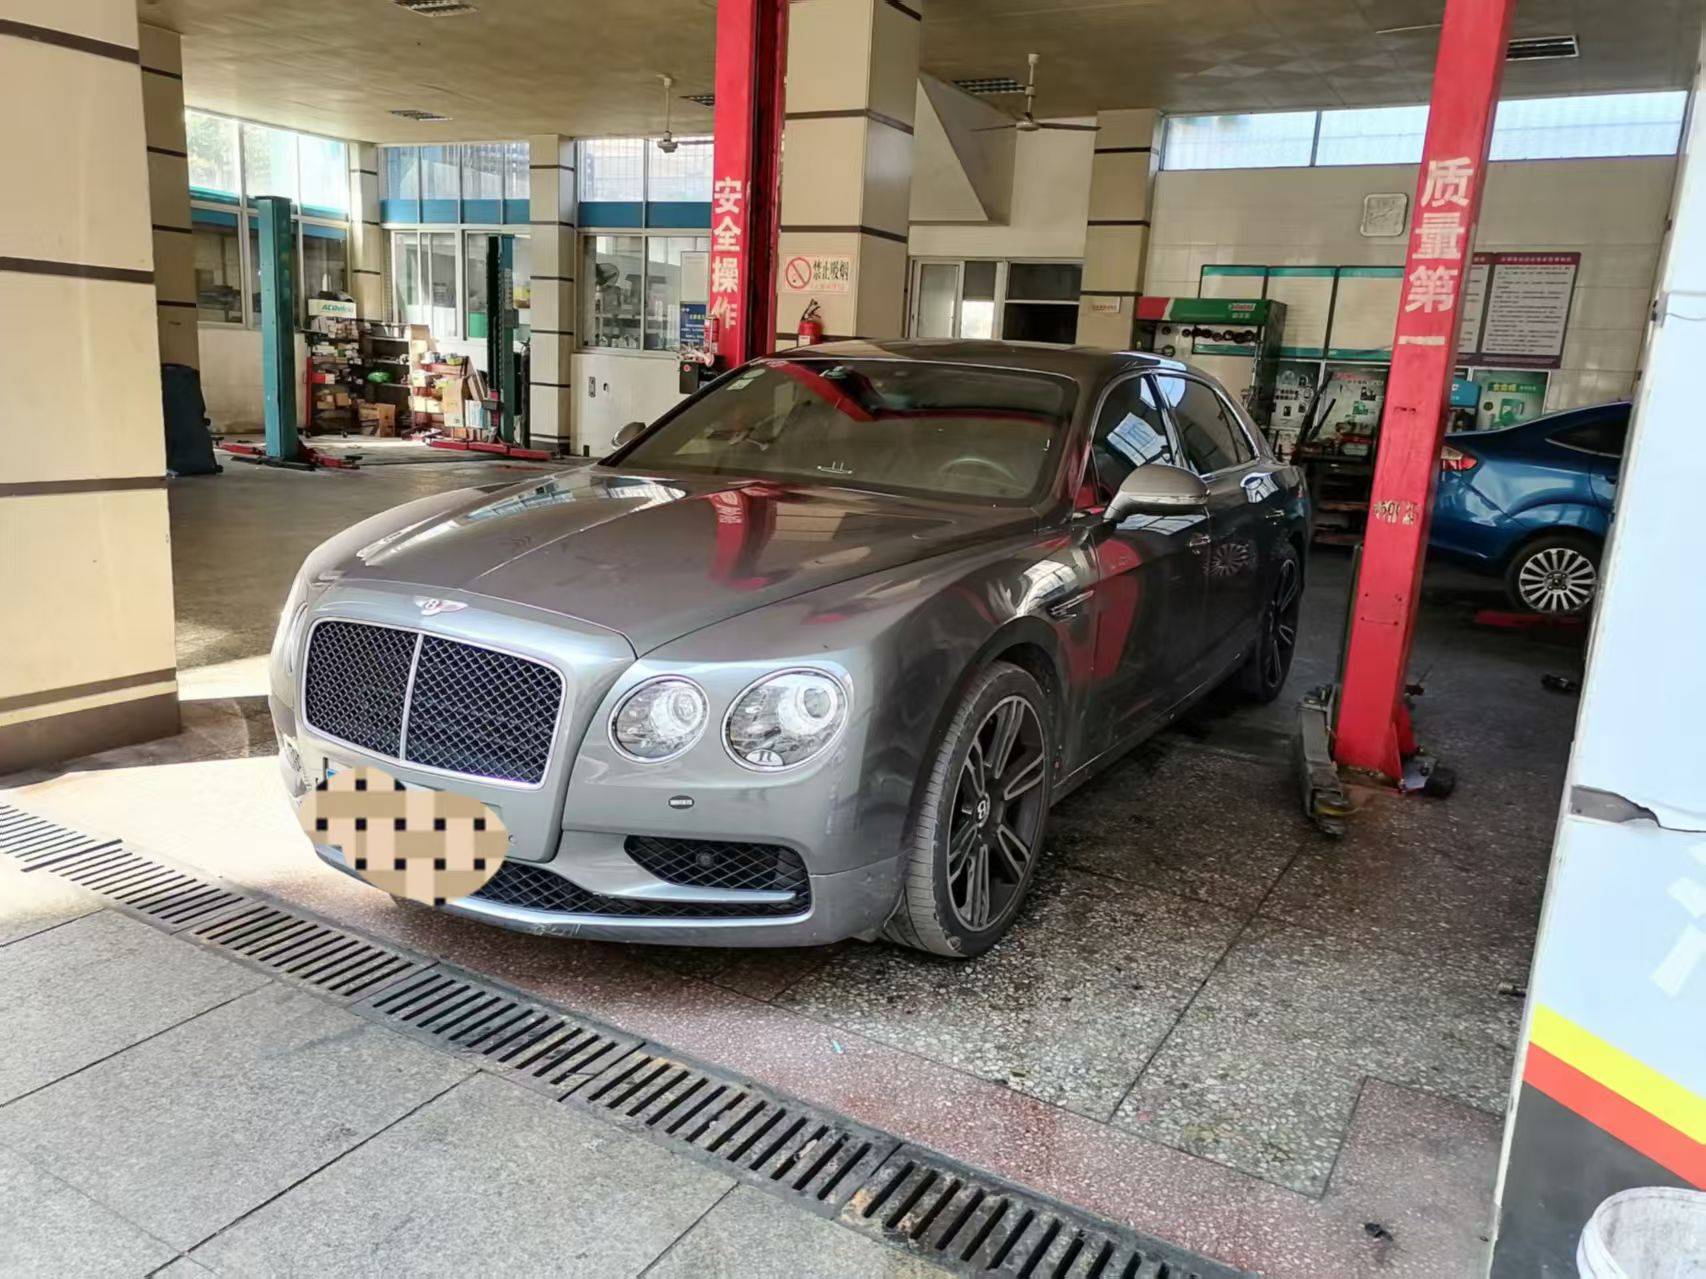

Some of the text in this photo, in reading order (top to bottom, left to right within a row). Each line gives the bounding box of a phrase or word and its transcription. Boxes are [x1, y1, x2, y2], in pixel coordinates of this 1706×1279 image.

[711, 176, 742, 329] 安全操作
[1398, 156, 1474, 346] 质量第一
